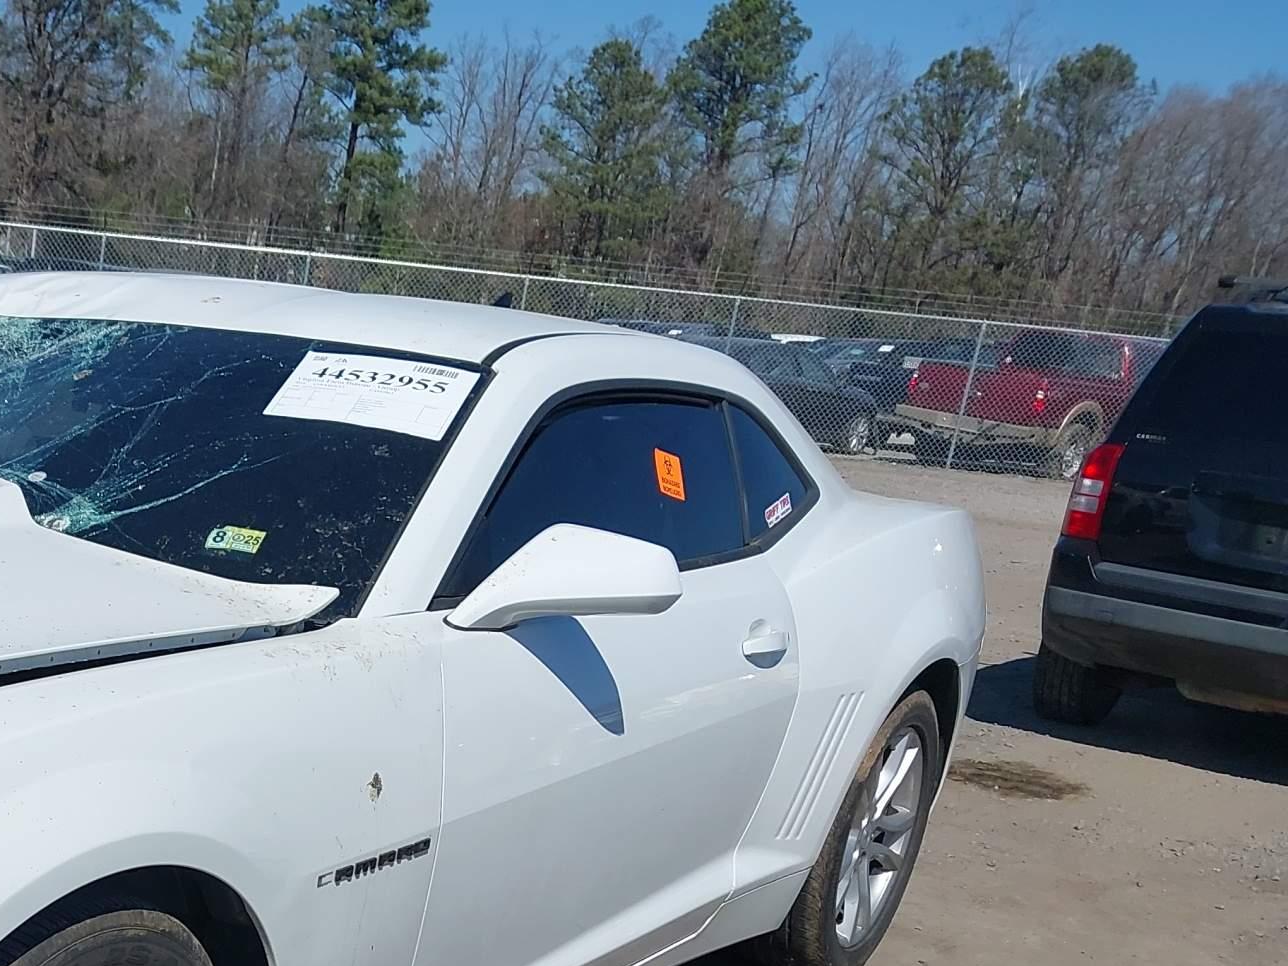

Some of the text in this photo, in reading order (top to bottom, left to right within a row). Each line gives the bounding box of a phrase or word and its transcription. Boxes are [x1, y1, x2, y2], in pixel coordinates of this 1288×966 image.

[312, 366, 450, 394] 44532955
[213, 531, 262, 545] 8 25
[317, 838, 431, 888] CAMARO
